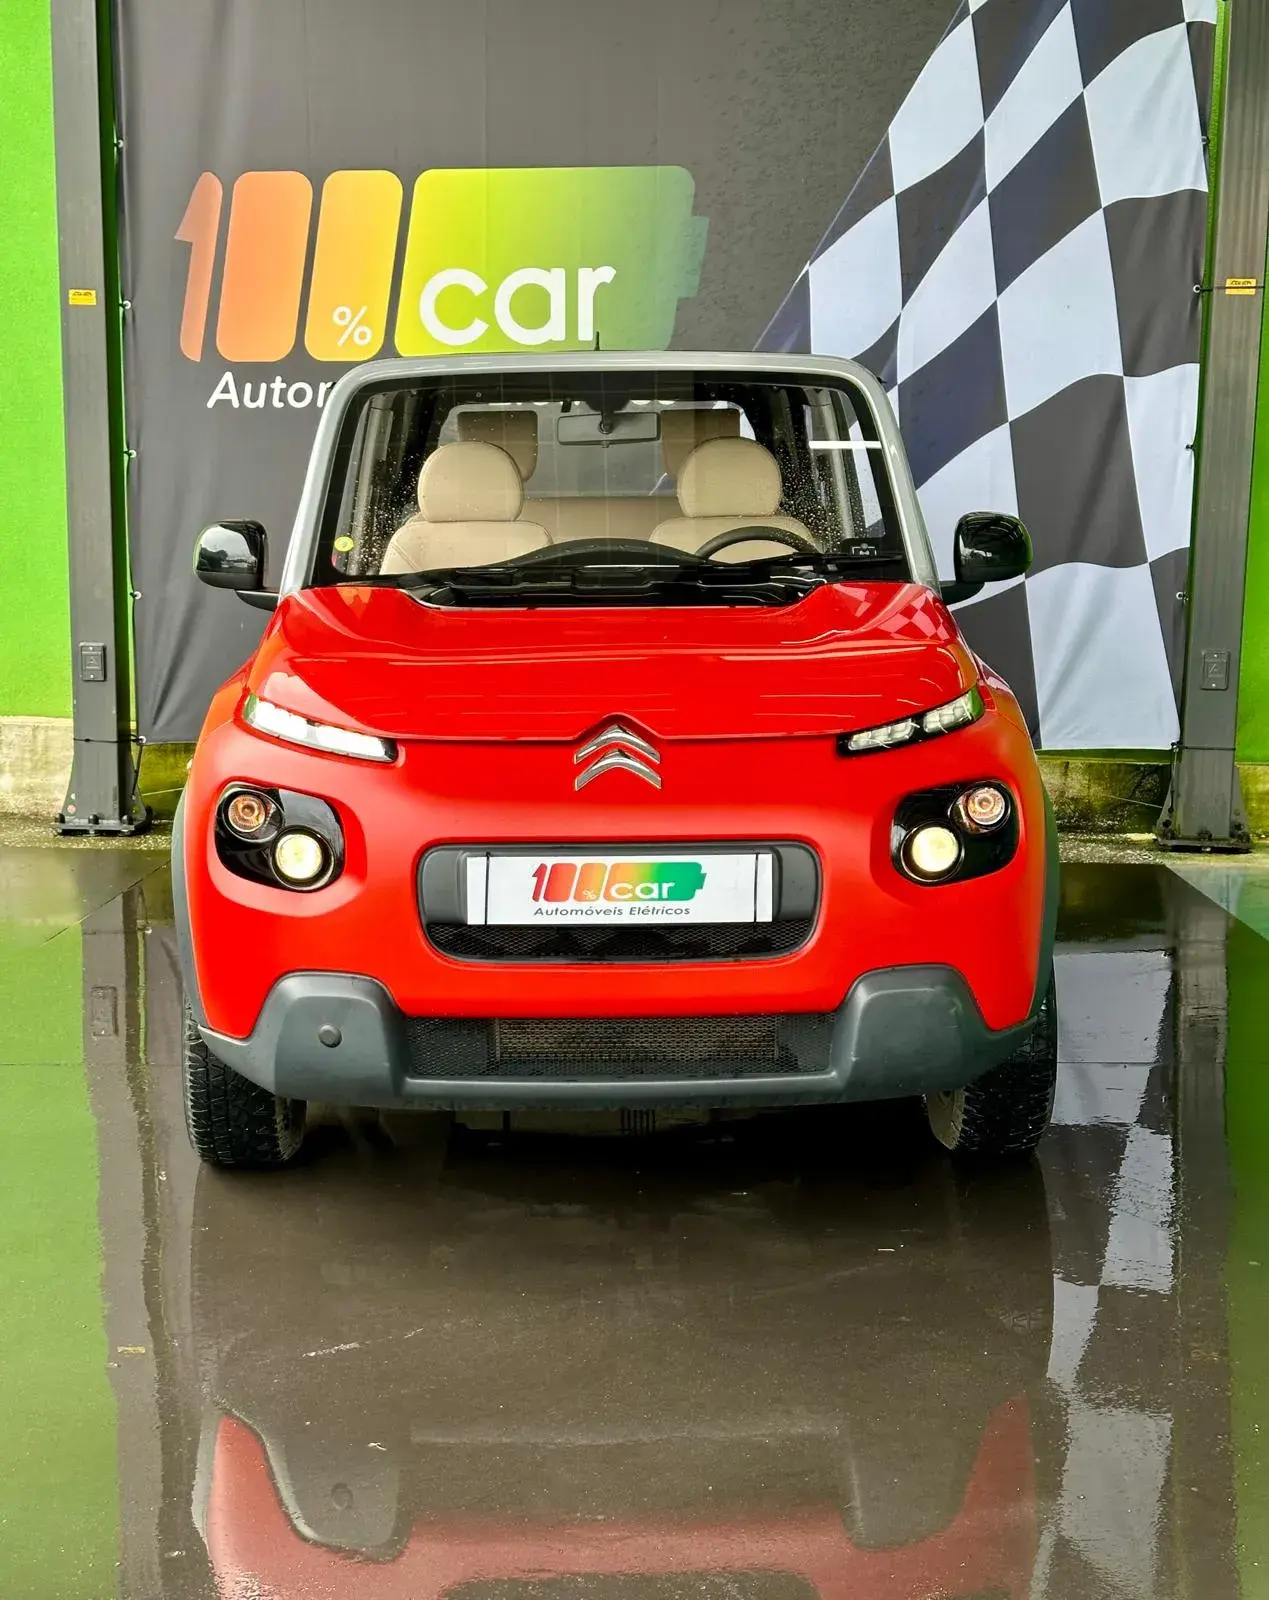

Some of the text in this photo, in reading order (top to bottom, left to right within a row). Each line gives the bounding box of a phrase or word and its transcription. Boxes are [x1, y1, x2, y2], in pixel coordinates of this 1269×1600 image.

[418, 264, 617, 346] car
[610, 881, 676, 900] car
[533, 905, 691, 917] Automóveis Elétricos
